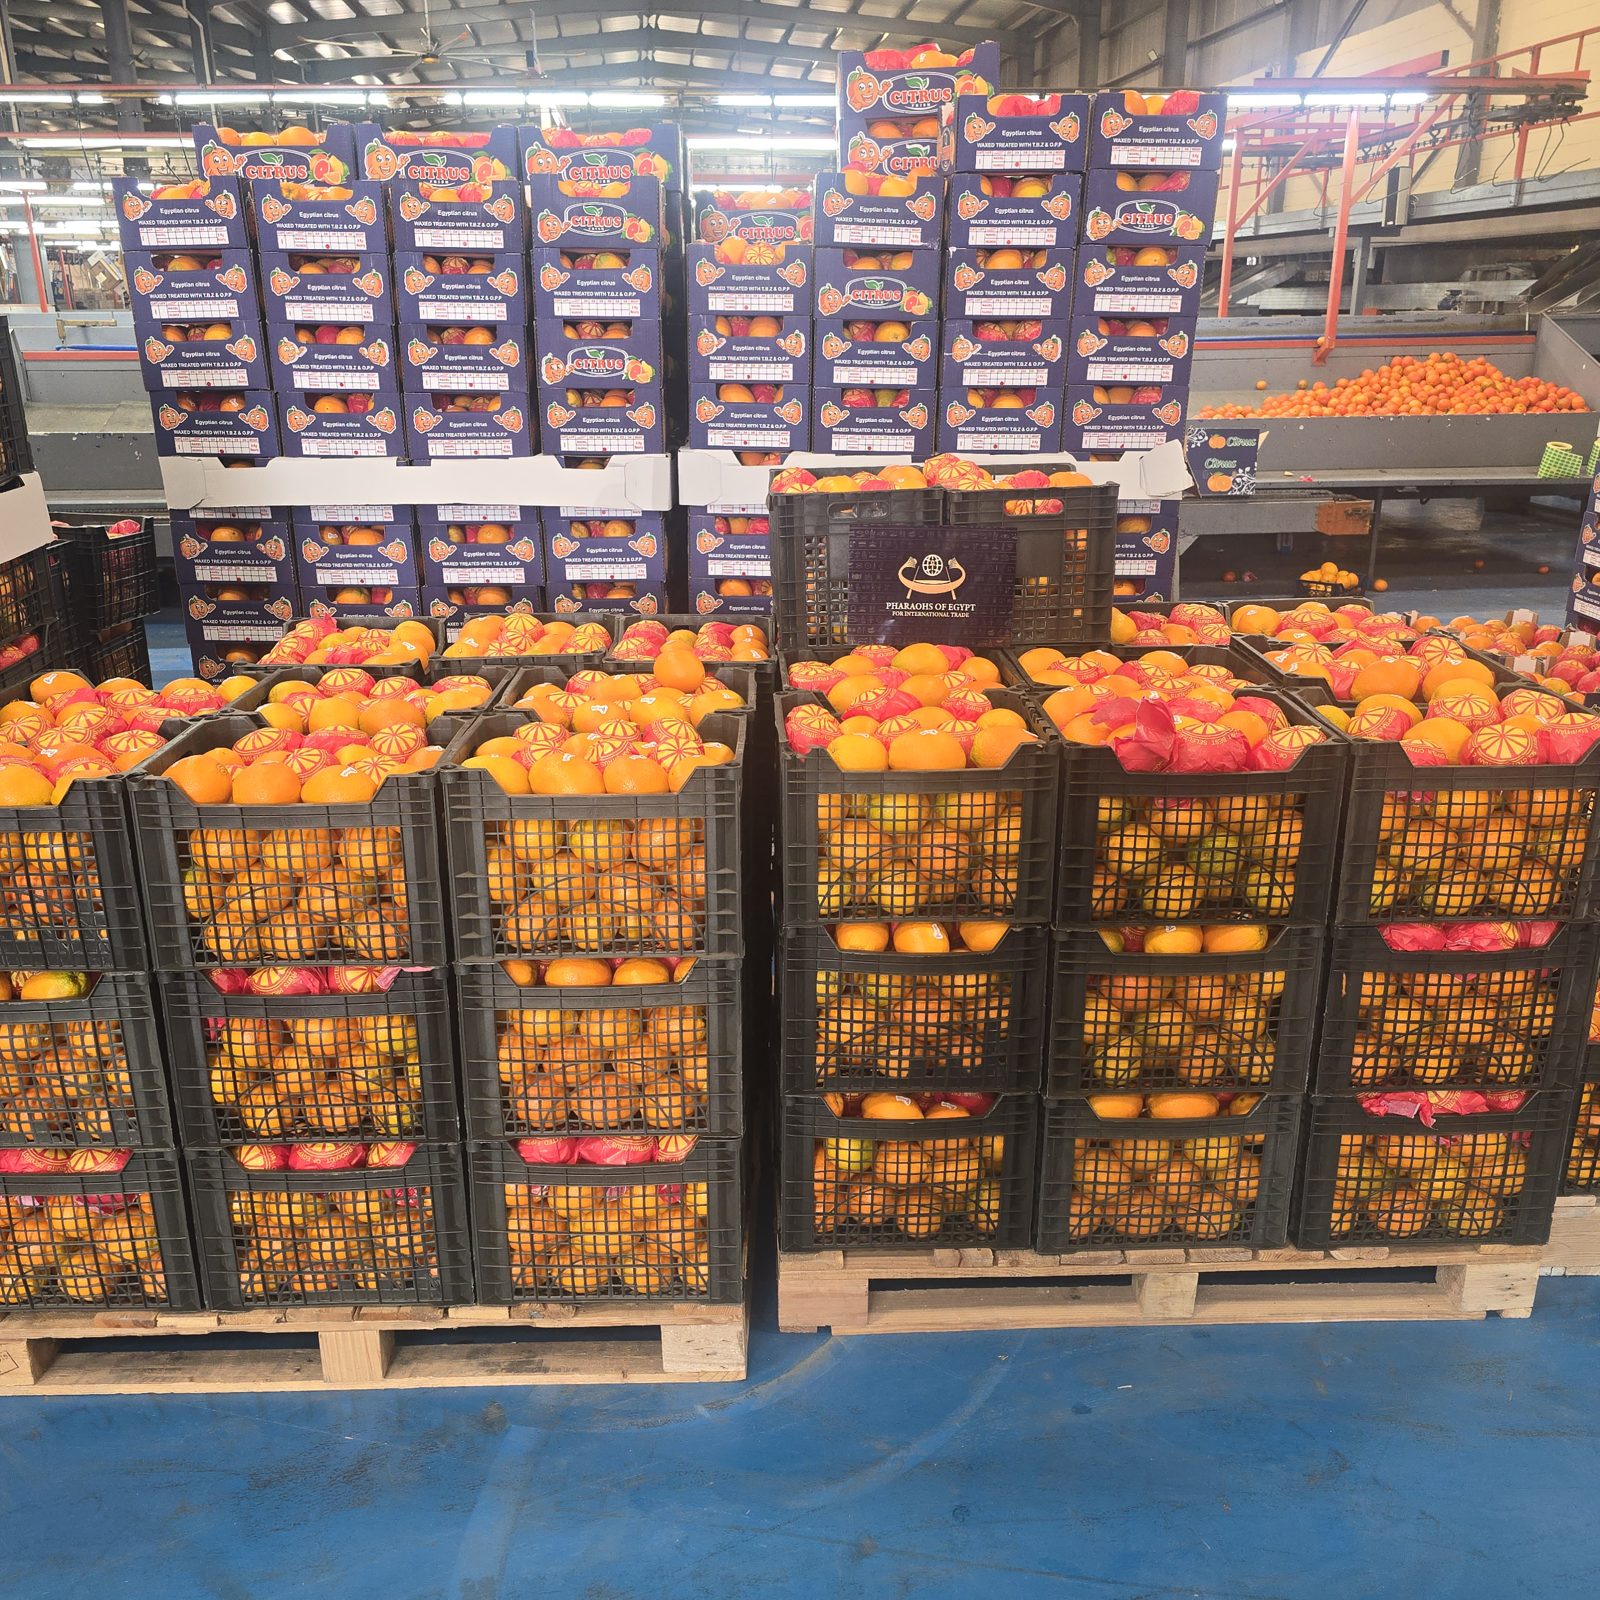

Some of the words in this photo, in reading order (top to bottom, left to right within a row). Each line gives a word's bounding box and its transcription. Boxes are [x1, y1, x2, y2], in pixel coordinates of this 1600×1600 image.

[890, 87, 952, 105] CITRUS
[890, 154, 938, 171] CITR
[246, 165, 307, 180] CITRUS
[407, 165, 469, 181] CITRUS
[569, 165, 631, 180] CITRUS
[571, 215, 622, 228] CITRUS
[1122, 213, 1173, 225] CITRUS
[738, 225, 794, 240] CITRUS
[852, 289, 902, 302] CITRUS
[574, 358, 624, 370] CITRUS
[1227, 437, 1256, 447] Citrus
[1205, 458, 1237, 469] Citrus
[886, 602, 933, 611] PHARAOHS
[934, 603, 946, 611] OF
[948, 603, 976, 611] EGYPT
